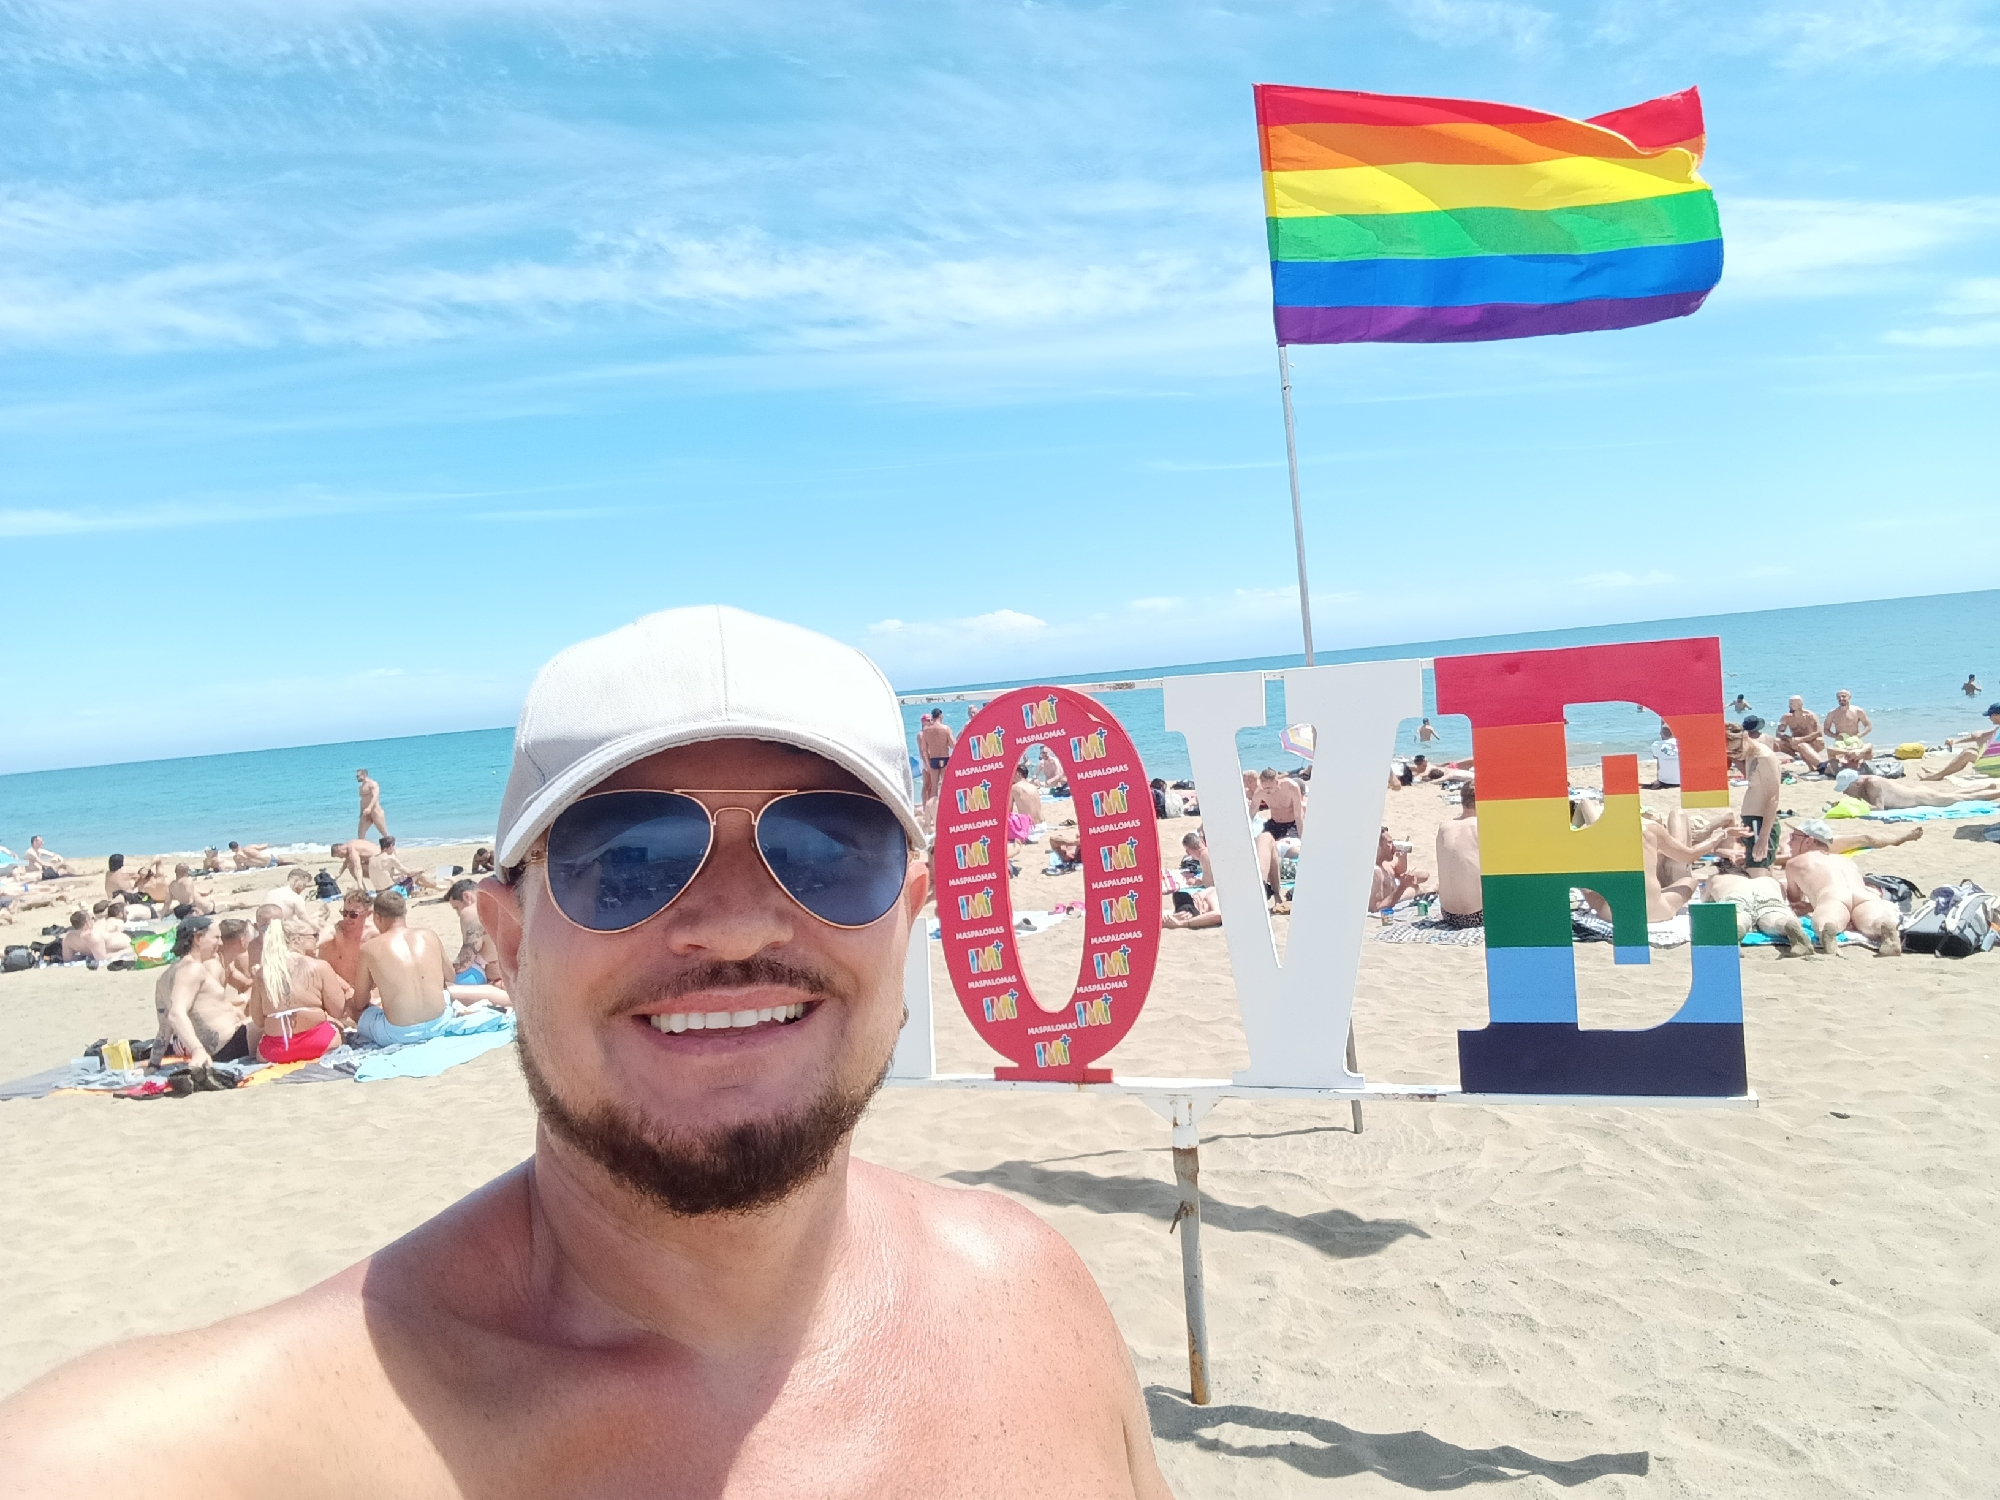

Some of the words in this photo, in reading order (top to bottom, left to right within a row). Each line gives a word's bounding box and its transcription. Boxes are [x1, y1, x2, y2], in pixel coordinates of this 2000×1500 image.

[1016, 728, 1066, 745] MASPALOMAS
[955, 761, 1004, 777] MASPALOMAS
[1077, 764, 1128, 781] MASPALOMAS
[949, 819, 997, 834] MASPALOMAS
[1088, 820, 1141, 835] MASPALOMAS
[949, 872, 997, 886] MASPALOMAS
[1091, 875, 1143, 890] MASPALOMAS
[956, 926, 1004, 940] MASPALOMAS
[1090, 930, 1143, 945] MASPALOMAS
[968, 975, 1017, 989] MASPALOMAS
[1077, 980, 1127, 993] MASPALOMAS
[1028, 1021, 1077, 1035] MASPALOMAS
